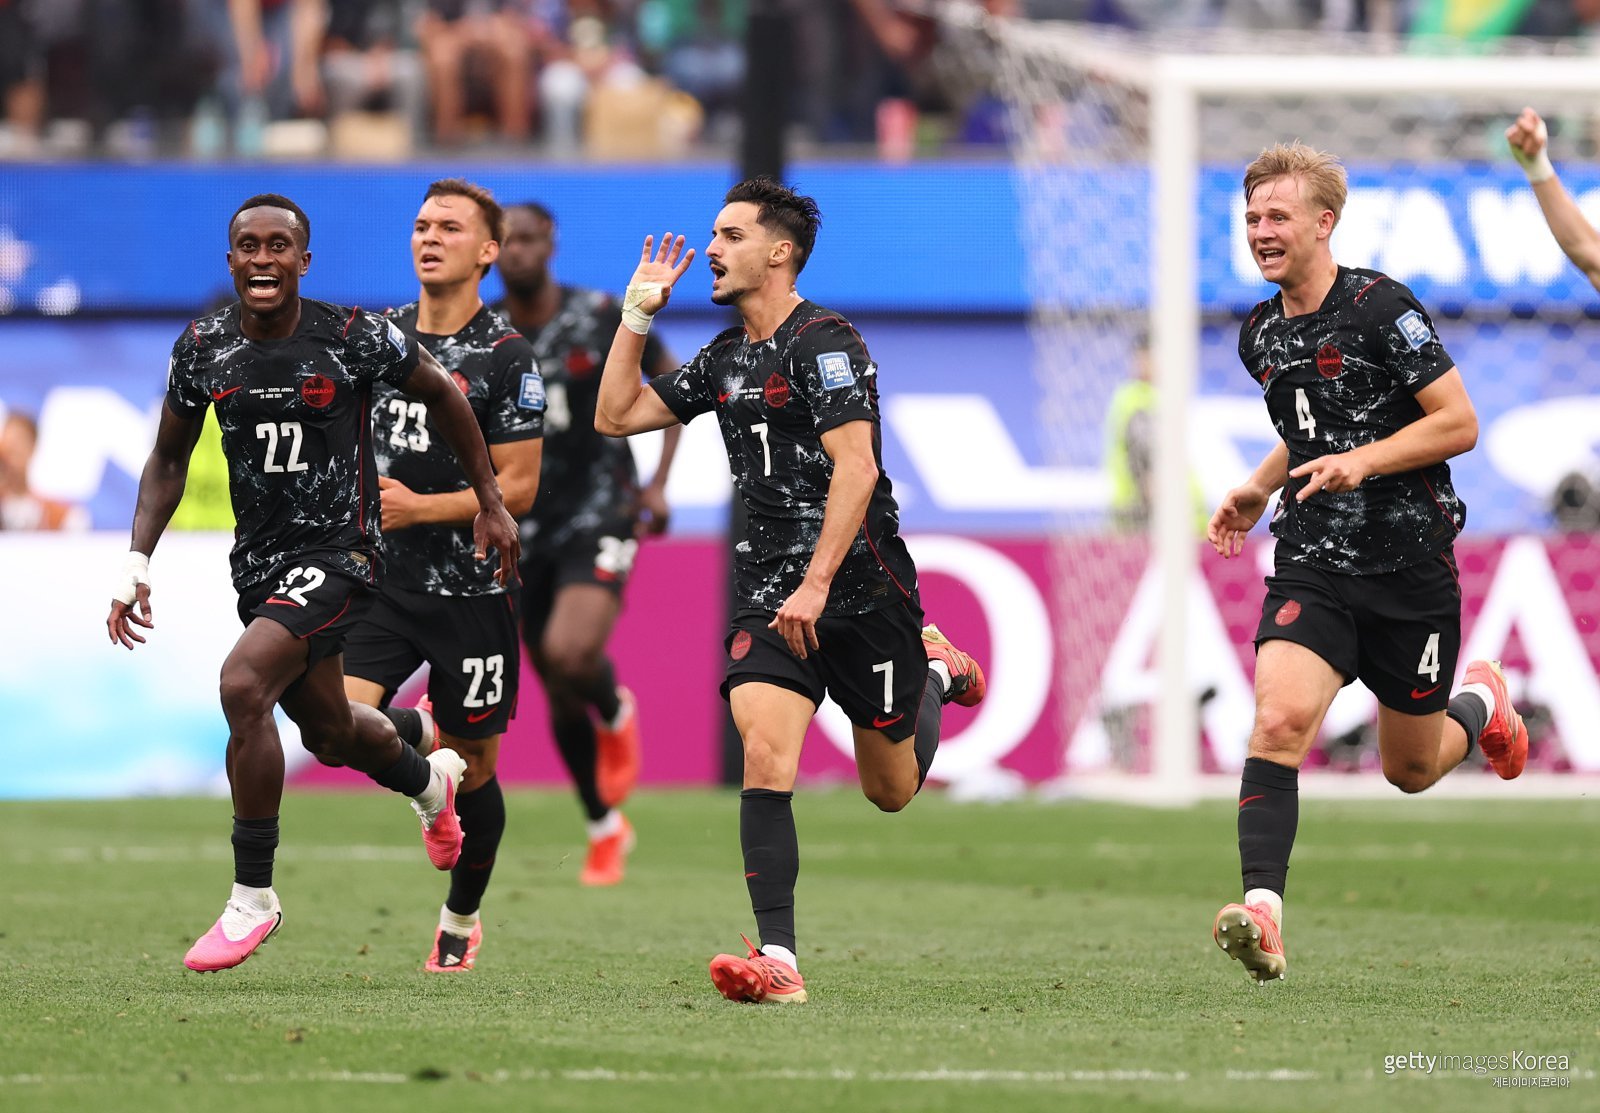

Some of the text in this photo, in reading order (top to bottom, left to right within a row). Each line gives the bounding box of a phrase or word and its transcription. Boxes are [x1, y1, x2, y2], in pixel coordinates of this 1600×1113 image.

[766, 386, 788, 394] CANADA
[1295, 388, 1317, 439] 4
[255, 421, 309, 473] 22
[388, 399, 430, 453] 23
[750, 422, 772, 477] 7
[462, 653, 504, 708] 23
[1417, 632, 1441, 684] 4
[872, 659, 894, 714] 7
